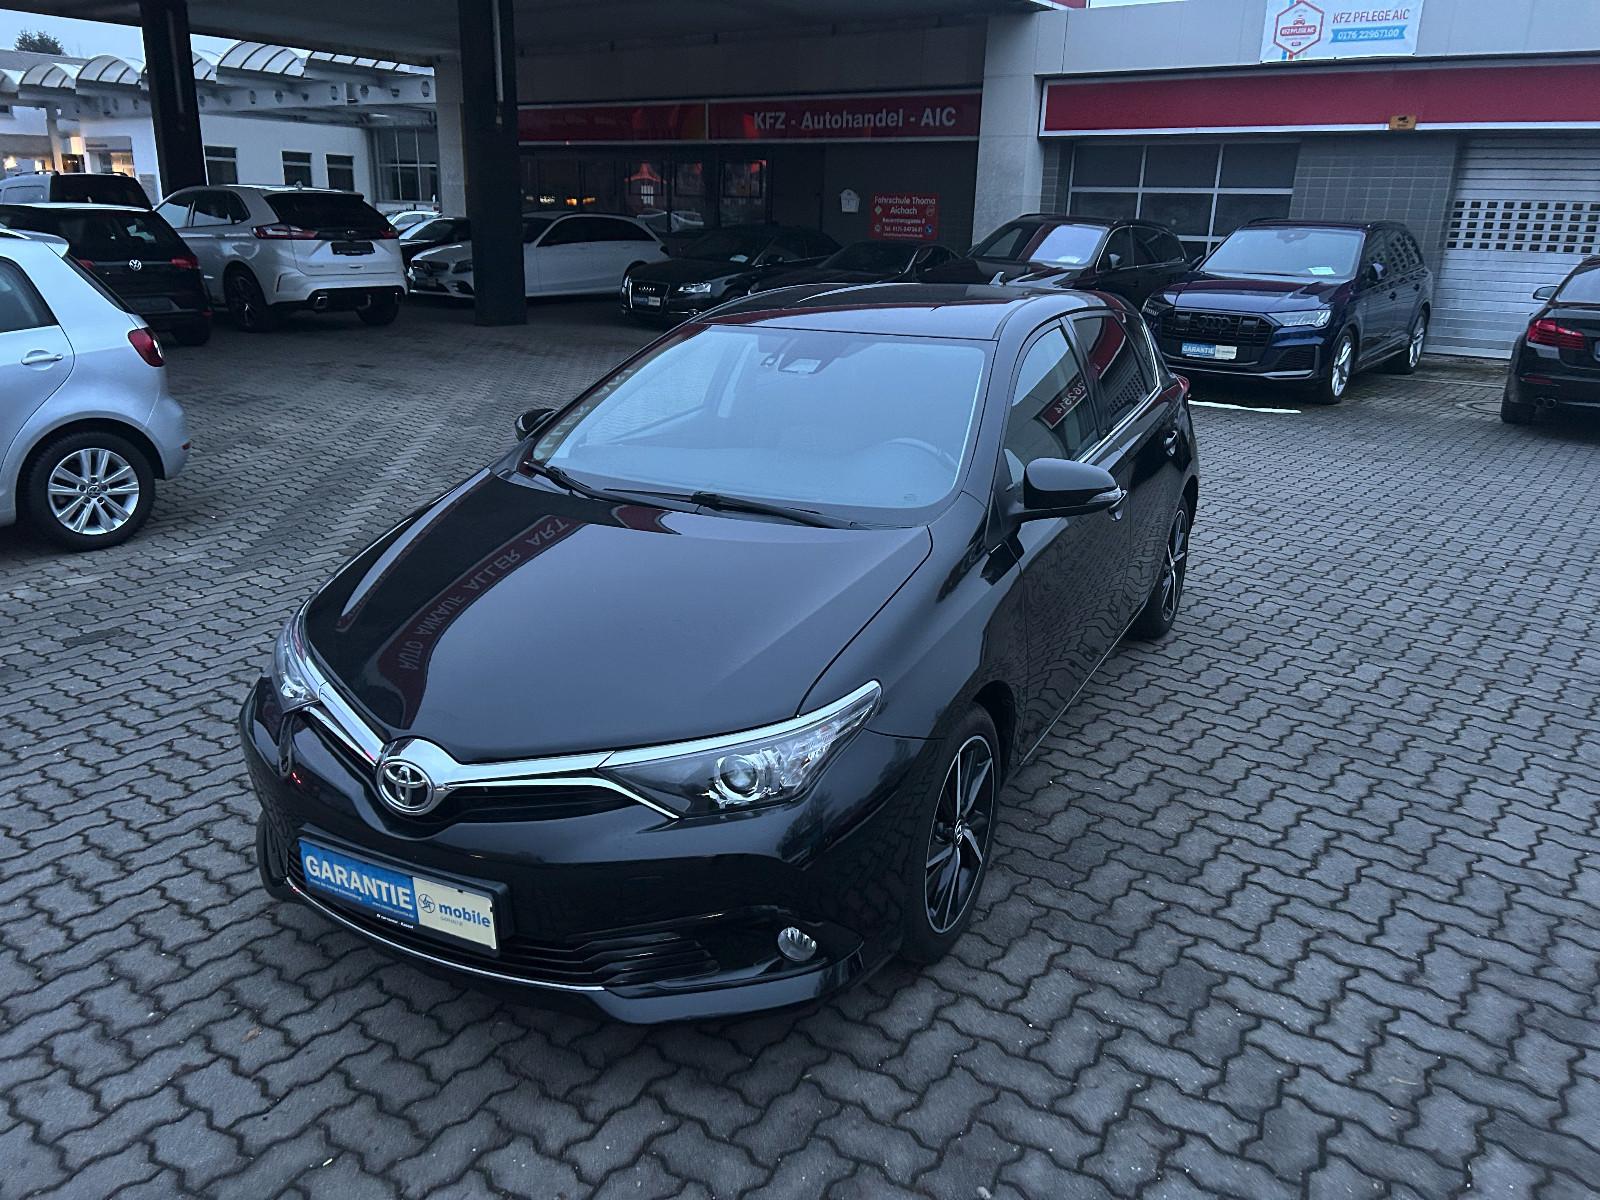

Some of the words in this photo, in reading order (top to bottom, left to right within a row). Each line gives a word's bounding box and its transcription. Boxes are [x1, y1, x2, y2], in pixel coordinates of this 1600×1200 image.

[1332, 13, 1352, 24] KFZ
[1353, 11, 1392, 23] PFLEGE
[1392, 9, 1410, 21] AIC
[754, 111, 786, 129] KFZ
[801, 108, 903, 129] Autohandel
[920, 107, 956, 127] AIC
[874, 195, 911, 205] Fahrschule
[890, 205, 918, 215] Aichach
[305, 855, 413, 910] GARANTIE
[438, 903, 491, 928] mobile
